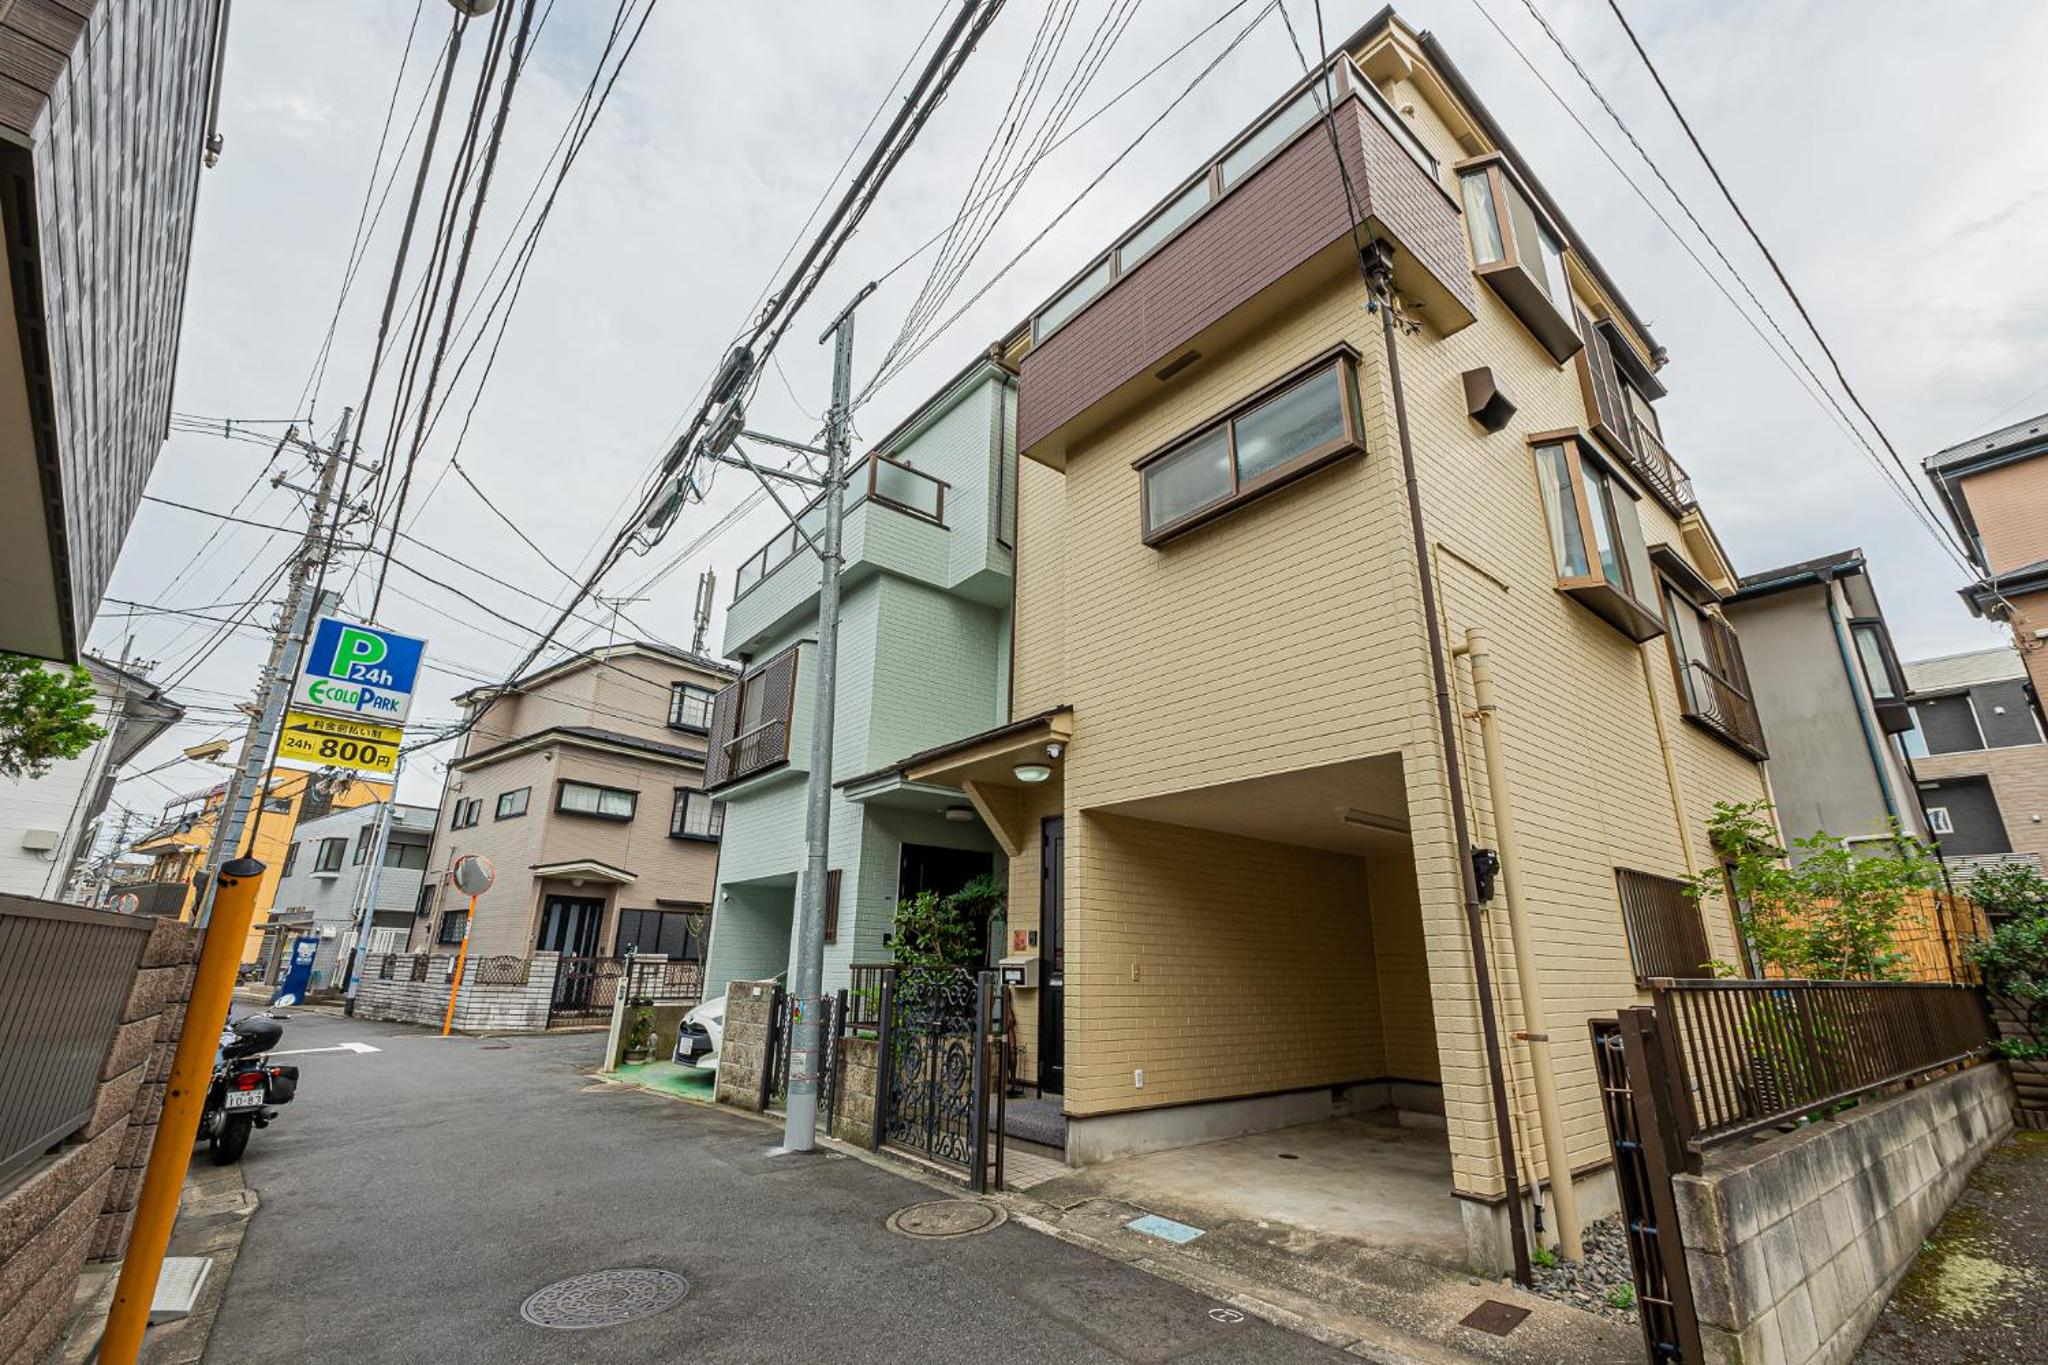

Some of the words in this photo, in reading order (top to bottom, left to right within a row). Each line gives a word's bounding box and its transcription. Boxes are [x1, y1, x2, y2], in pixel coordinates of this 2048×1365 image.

[329, 626, 387, 679] P
[351, 665, 393, 687] 24h
[286, 736, 312, 751] 24h
